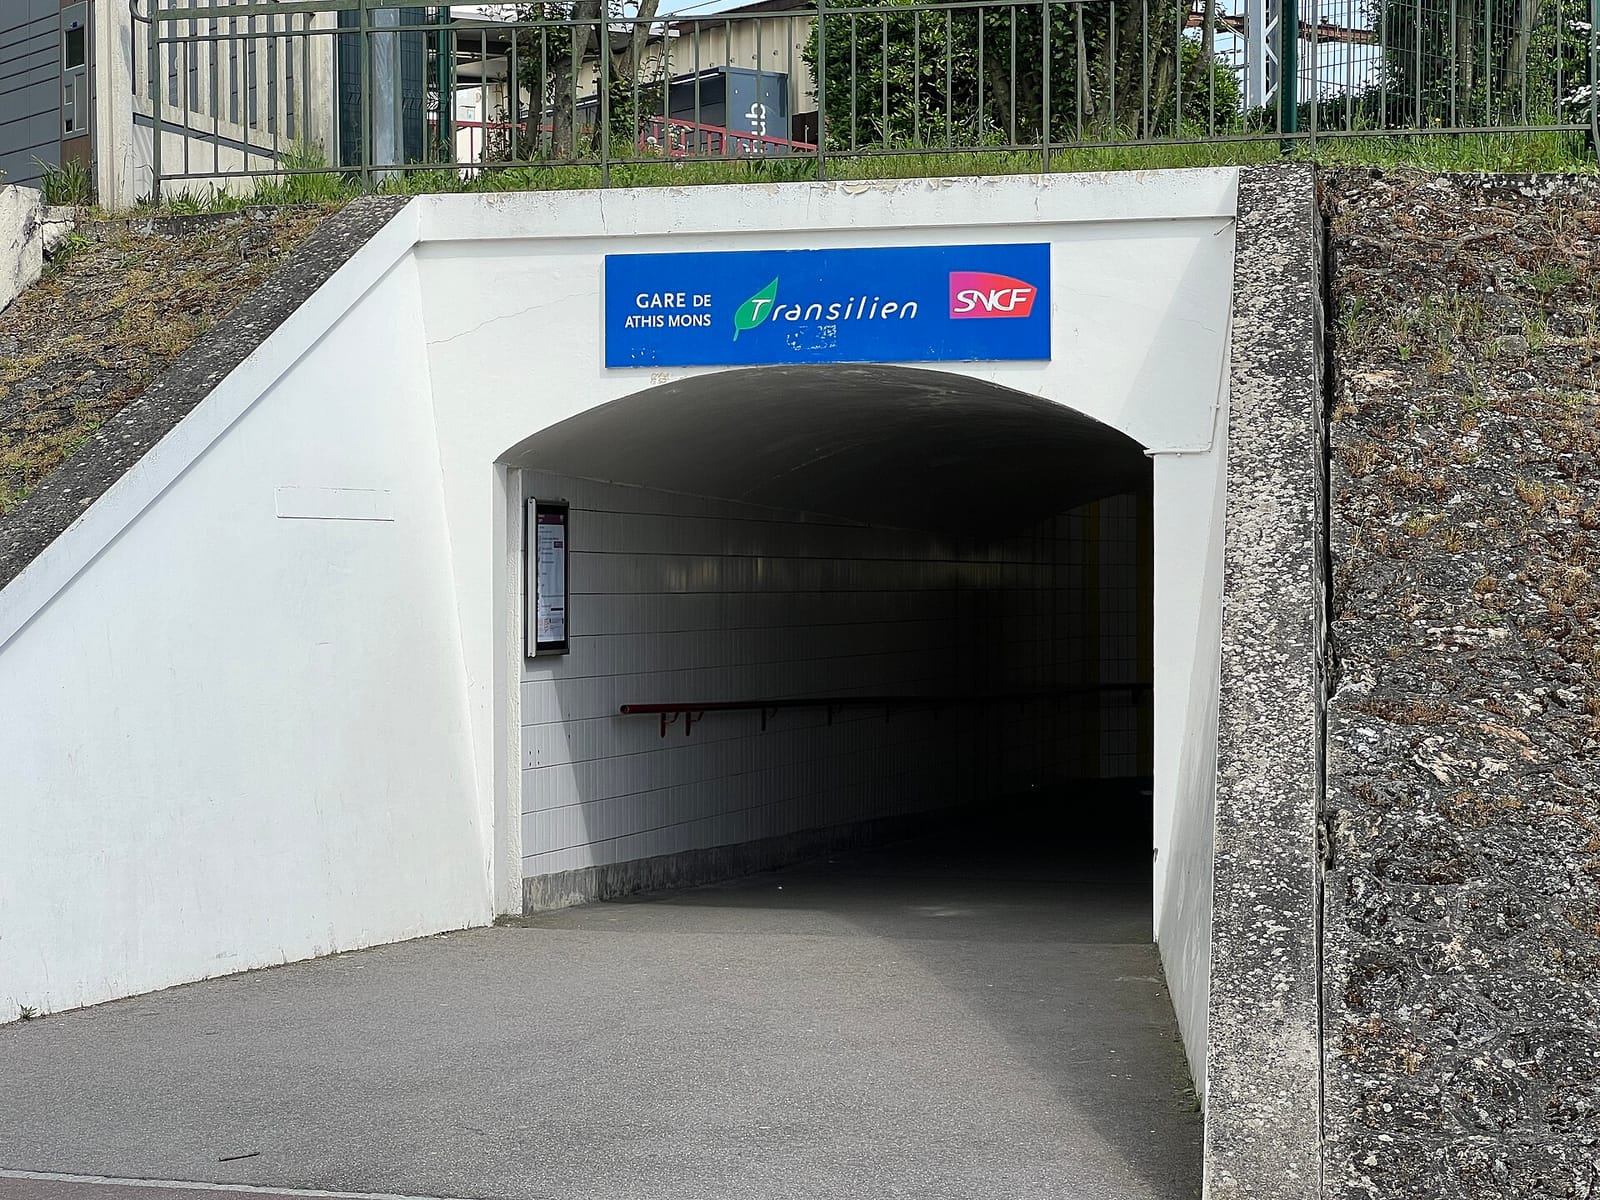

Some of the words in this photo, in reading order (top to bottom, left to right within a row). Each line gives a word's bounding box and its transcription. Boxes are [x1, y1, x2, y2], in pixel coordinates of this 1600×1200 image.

[636, 292, 686, 308] GARE
[693, 294, 711, 307] DE
[751, 295, 918, 321] Transilien
[953, 288, 1032, 312] SNCF
[624, 315, 664, 328] ATHIS
[668, 314, 711, 327] MONS
